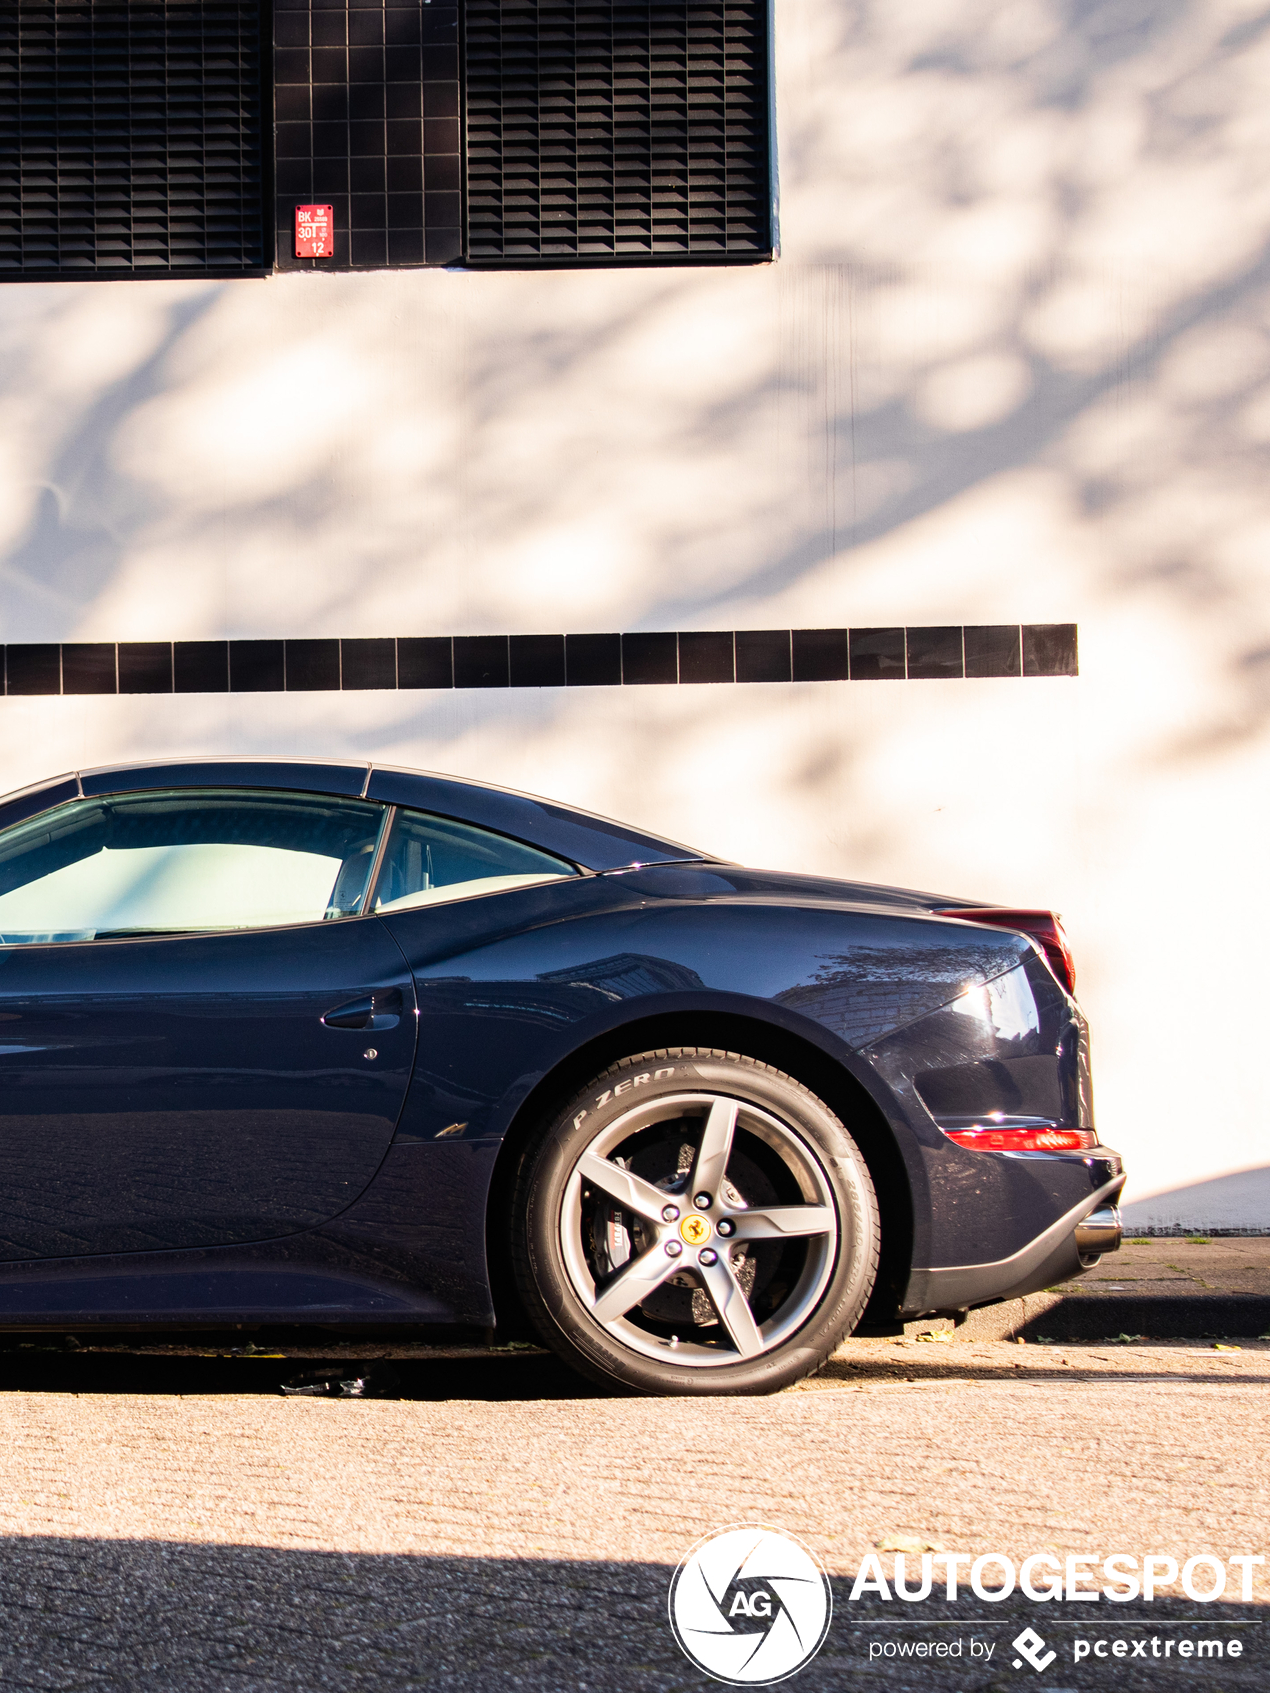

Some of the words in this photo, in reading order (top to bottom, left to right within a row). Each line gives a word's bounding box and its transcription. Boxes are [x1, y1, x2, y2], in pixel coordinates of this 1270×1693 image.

[298, 211, 312, 222] BK
[311, 242, 324, 253] 12
[595, 1066, 676, 1107] ZERO
